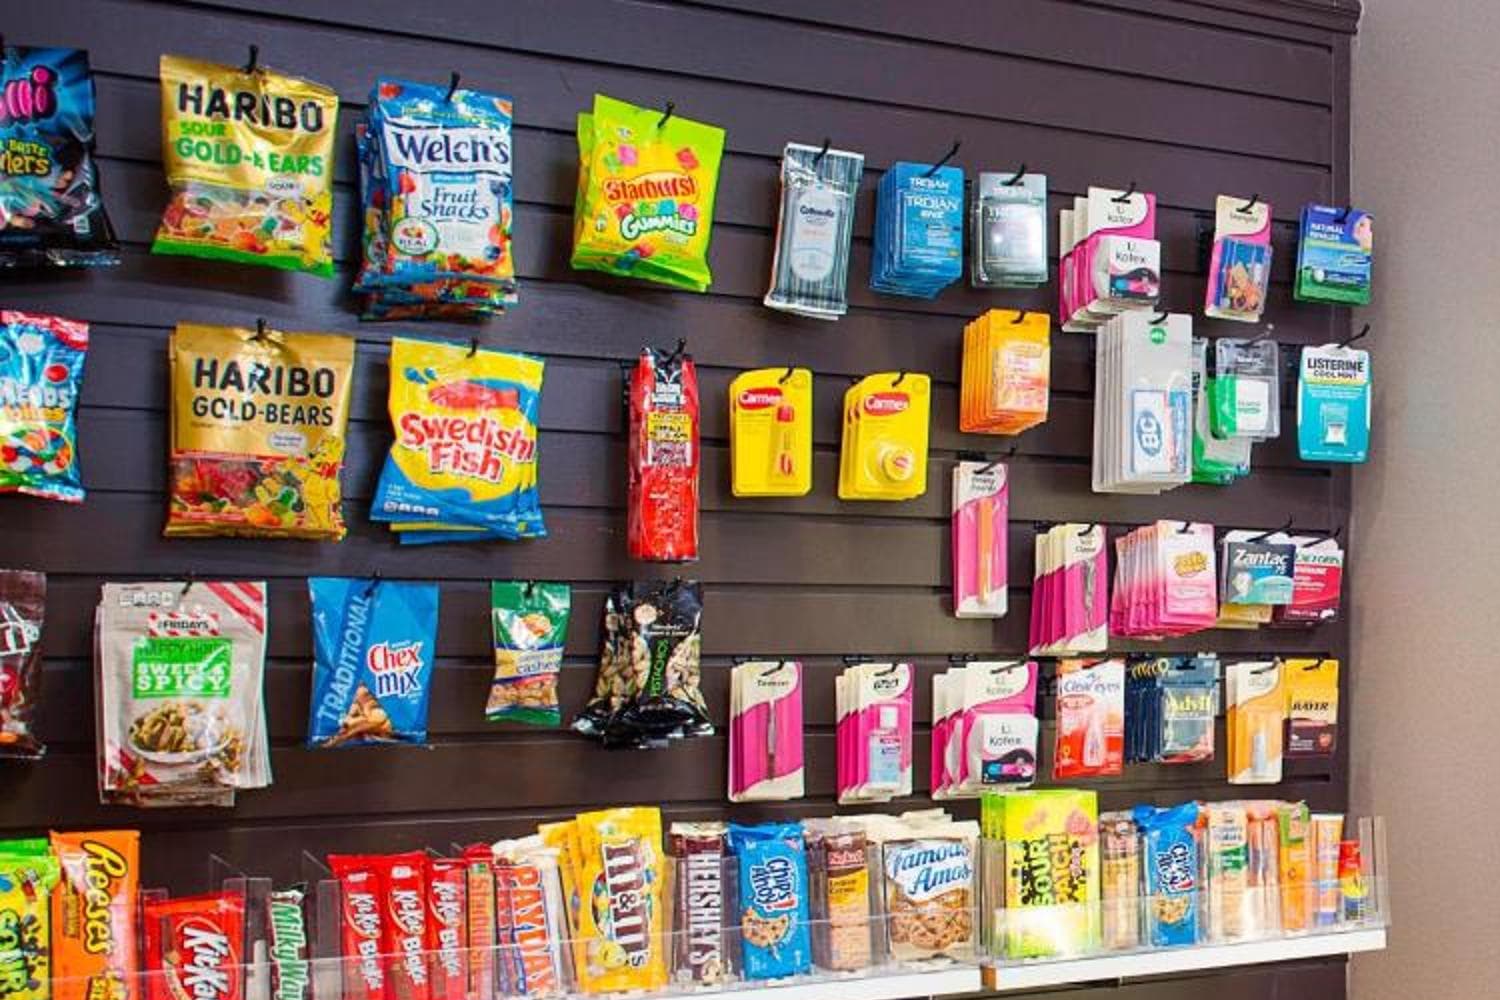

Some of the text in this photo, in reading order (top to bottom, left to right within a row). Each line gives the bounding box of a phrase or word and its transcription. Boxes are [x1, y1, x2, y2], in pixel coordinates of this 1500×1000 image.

[178, 83, 324, 132] HARIBO
[180, 121, 226, 137] SOUR
[392, 132, 510, 165] Welch's
[434, 186, 479, 204] Fruit
[606, 174, 697, 202] Starburst
[905, 195, 961, 210] TROJAN
[420, 199, 490, 220] Snacks
[193, 358, 335, 399] HARIBO
[1307, 358, 1364, 373] LISTERINE
[193, 396, 334, 427] GOLD-BEARS
[400, 413, 535, 464] Swedish
[429, 443, 501, 482] Fish
[1233, 549, 1288, 565] Zantac
[319, 593, 371, 722] TRADITIONAL
[369, 643, 422, 669] Chex
[376, 668, 421, 696] mix
[889, 843, 969, 877] Famous
[1032, 839, 1051, 905] SOUR
[768, 858, 793, 902] Chips
[909, 867, 973, 895] Amos
[81, 840, 128, 954] Reese's
[687, 854, 721, 965] HERSHEY'S
[511, 865, 556, 994] PAYDAY
